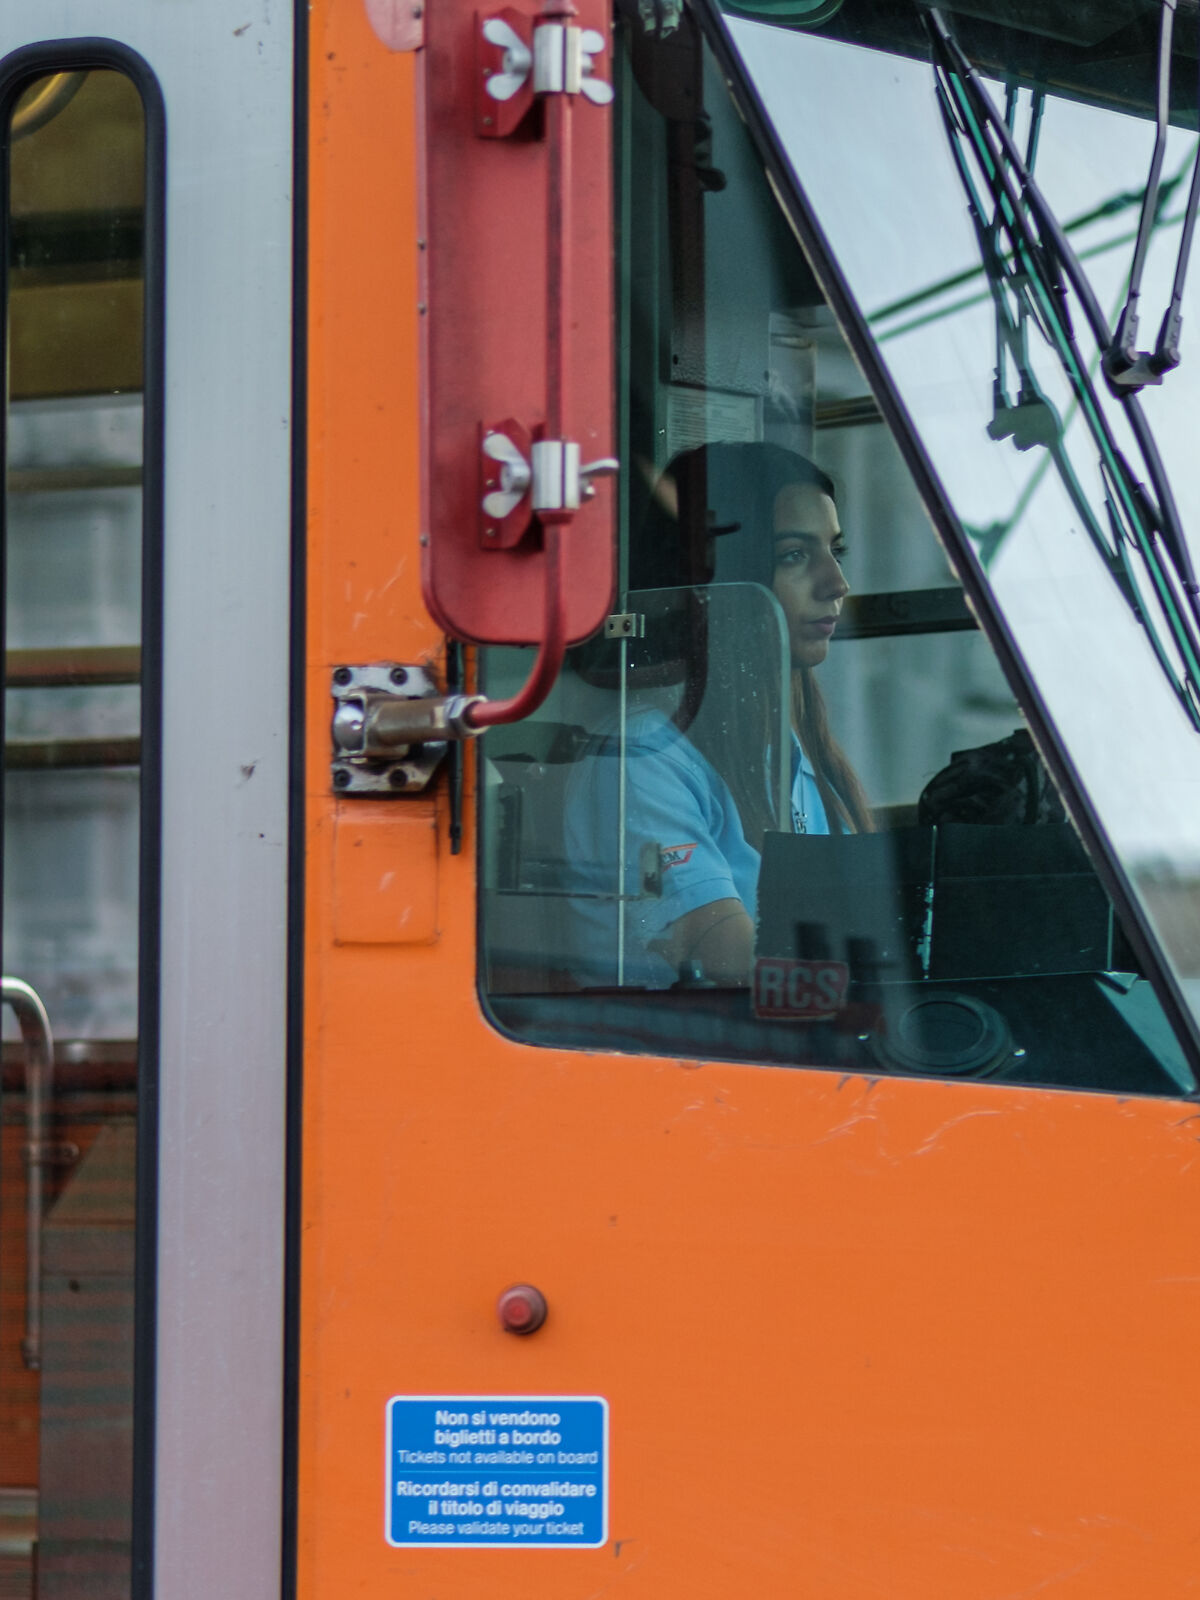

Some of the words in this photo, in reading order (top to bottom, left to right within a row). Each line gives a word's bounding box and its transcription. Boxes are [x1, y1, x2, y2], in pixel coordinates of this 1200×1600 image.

[760, 965, 840, 1010] RCS
[435, 1410, 468, 1425] Non
[471, 1410, 486, 1425] si
[489, 1411, 560, 1425] vendono
[434, 1430, 496, 1447] biglietti
[499, 1433, 509, 1445] a
[513, 1430, 561, 1445] bordo
[398, 1450, 446, 1463] Tickets
[449, 1452, 471, 1463] not
[474, 1450, 534, 1464] available
[537, 1454, 555, 1464] on
[558, 1451, 598, 1464] board
[397, 1481, 479, 1496] Ricordarsi
[482, 1482, 498, 1496] di
[501, 1482, 596, 1497] convalidare
[429, 1501, 437, 1515] il
[441, 1501, 483, 1515] titolo
[486, 1501, 502, 1515] di
[505, 1501, 564, 1519] viaggio
[409, 1521, 455, 1534] Please
[458, 1522, 510, 1534] validate
[513, 1524, 544, 1537] your
[546, 1522, 584, 1534] ticket
